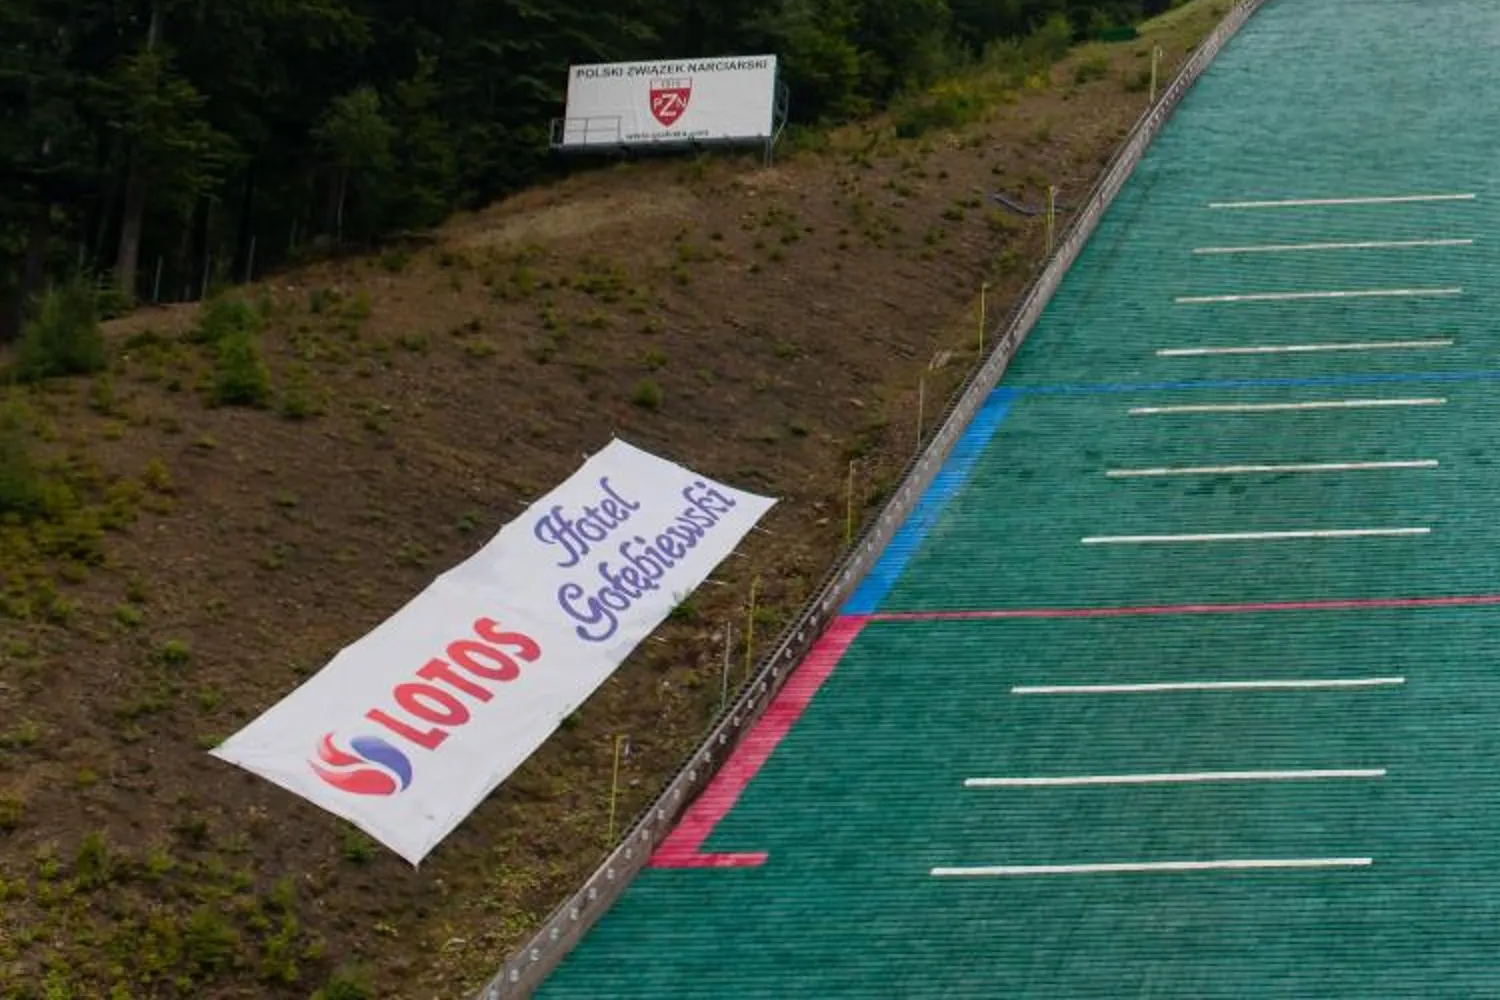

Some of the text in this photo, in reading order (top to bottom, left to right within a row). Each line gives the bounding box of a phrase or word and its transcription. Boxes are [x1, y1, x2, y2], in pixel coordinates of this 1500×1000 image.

[576, 67, 623, 79] POLSKI
[687, 60, 767, 73] NARCIARSKI
[653, 93, 687, 117] PZN
[534, 476, 640, 568] Hotel
[557, 481, 737, 642] Gołębiewski
[365, 617, 541, 751] LOTOS
